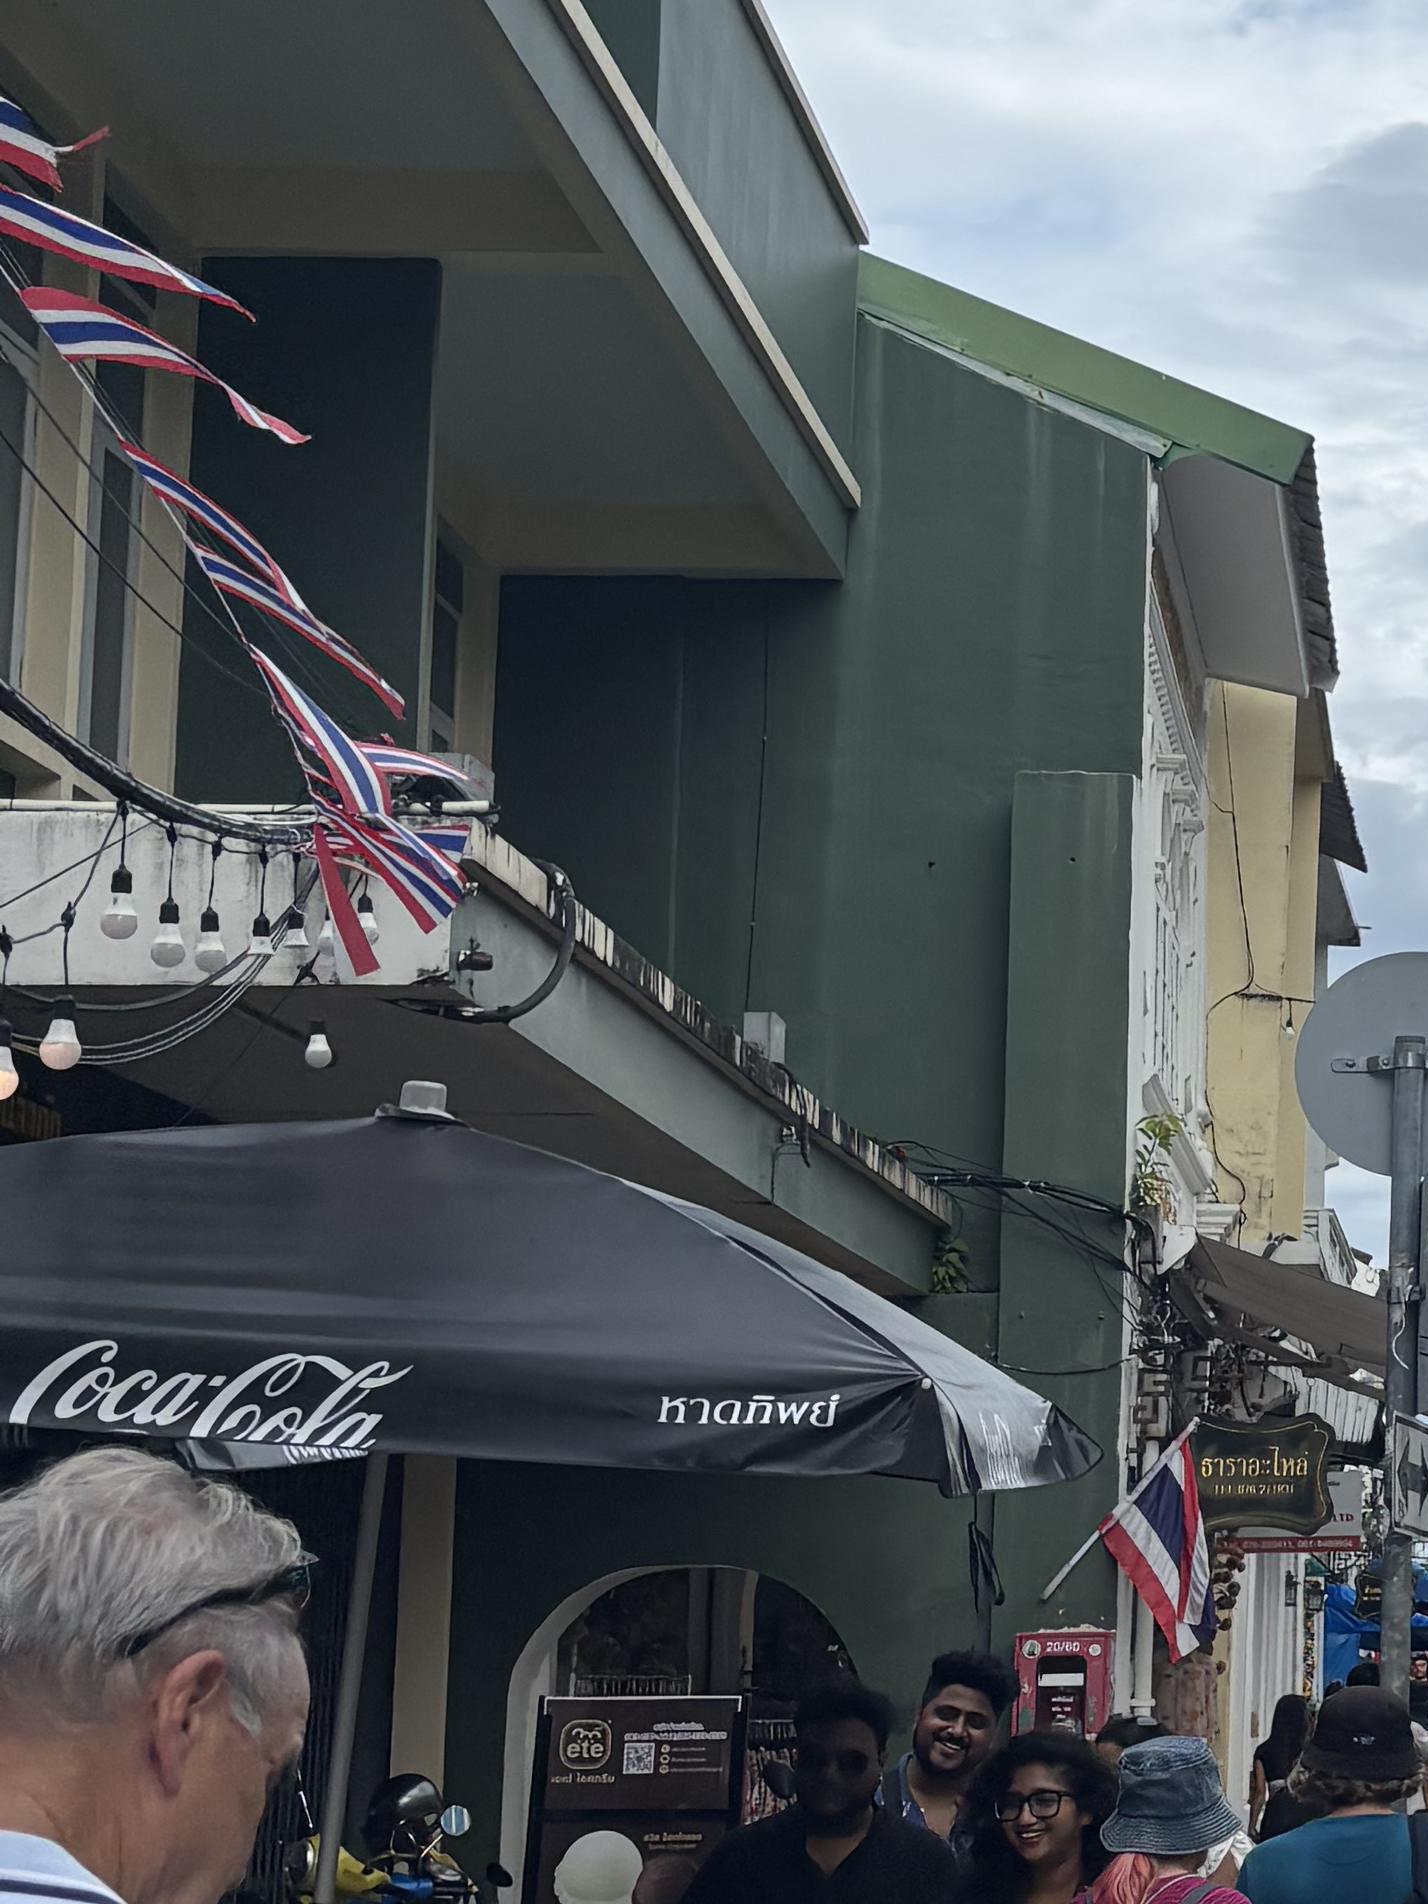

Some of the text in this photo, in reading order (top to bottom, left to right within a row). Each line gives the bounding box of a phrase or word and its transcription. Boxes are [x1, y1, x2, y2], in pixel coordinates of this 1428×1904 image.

[8, 1339, 414, 1449] Coca-Cola
[657, 1394, 841, 1428] หาดทิพย์
[1201, 1446, 1308, 1478] ธาราอะไหล่
